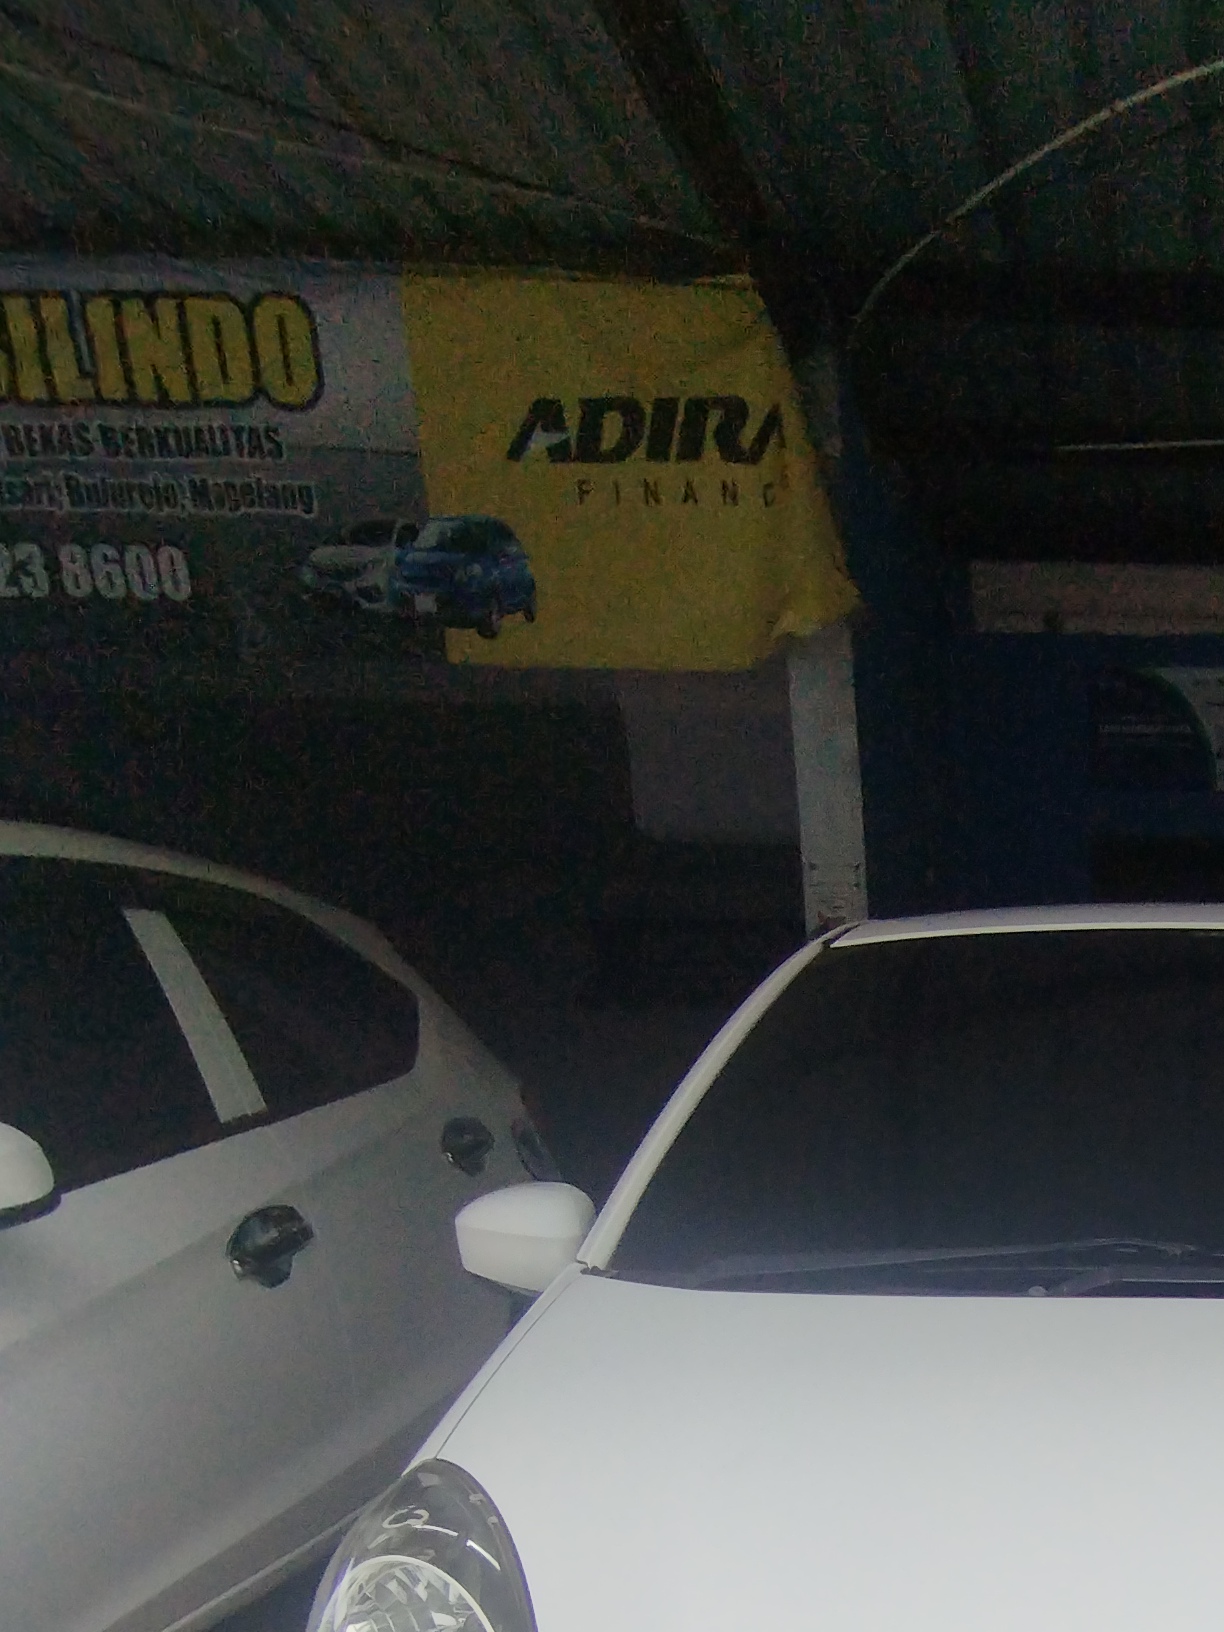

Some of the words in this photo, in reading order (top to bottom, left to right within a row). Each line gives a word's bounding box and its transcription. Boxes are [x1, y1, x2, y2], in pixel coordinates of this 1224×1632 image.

[0, 291, 323, 409] ILINDO
[576, 478, 789, 507] FINANC
[58, 543, 192, 602] 8600
